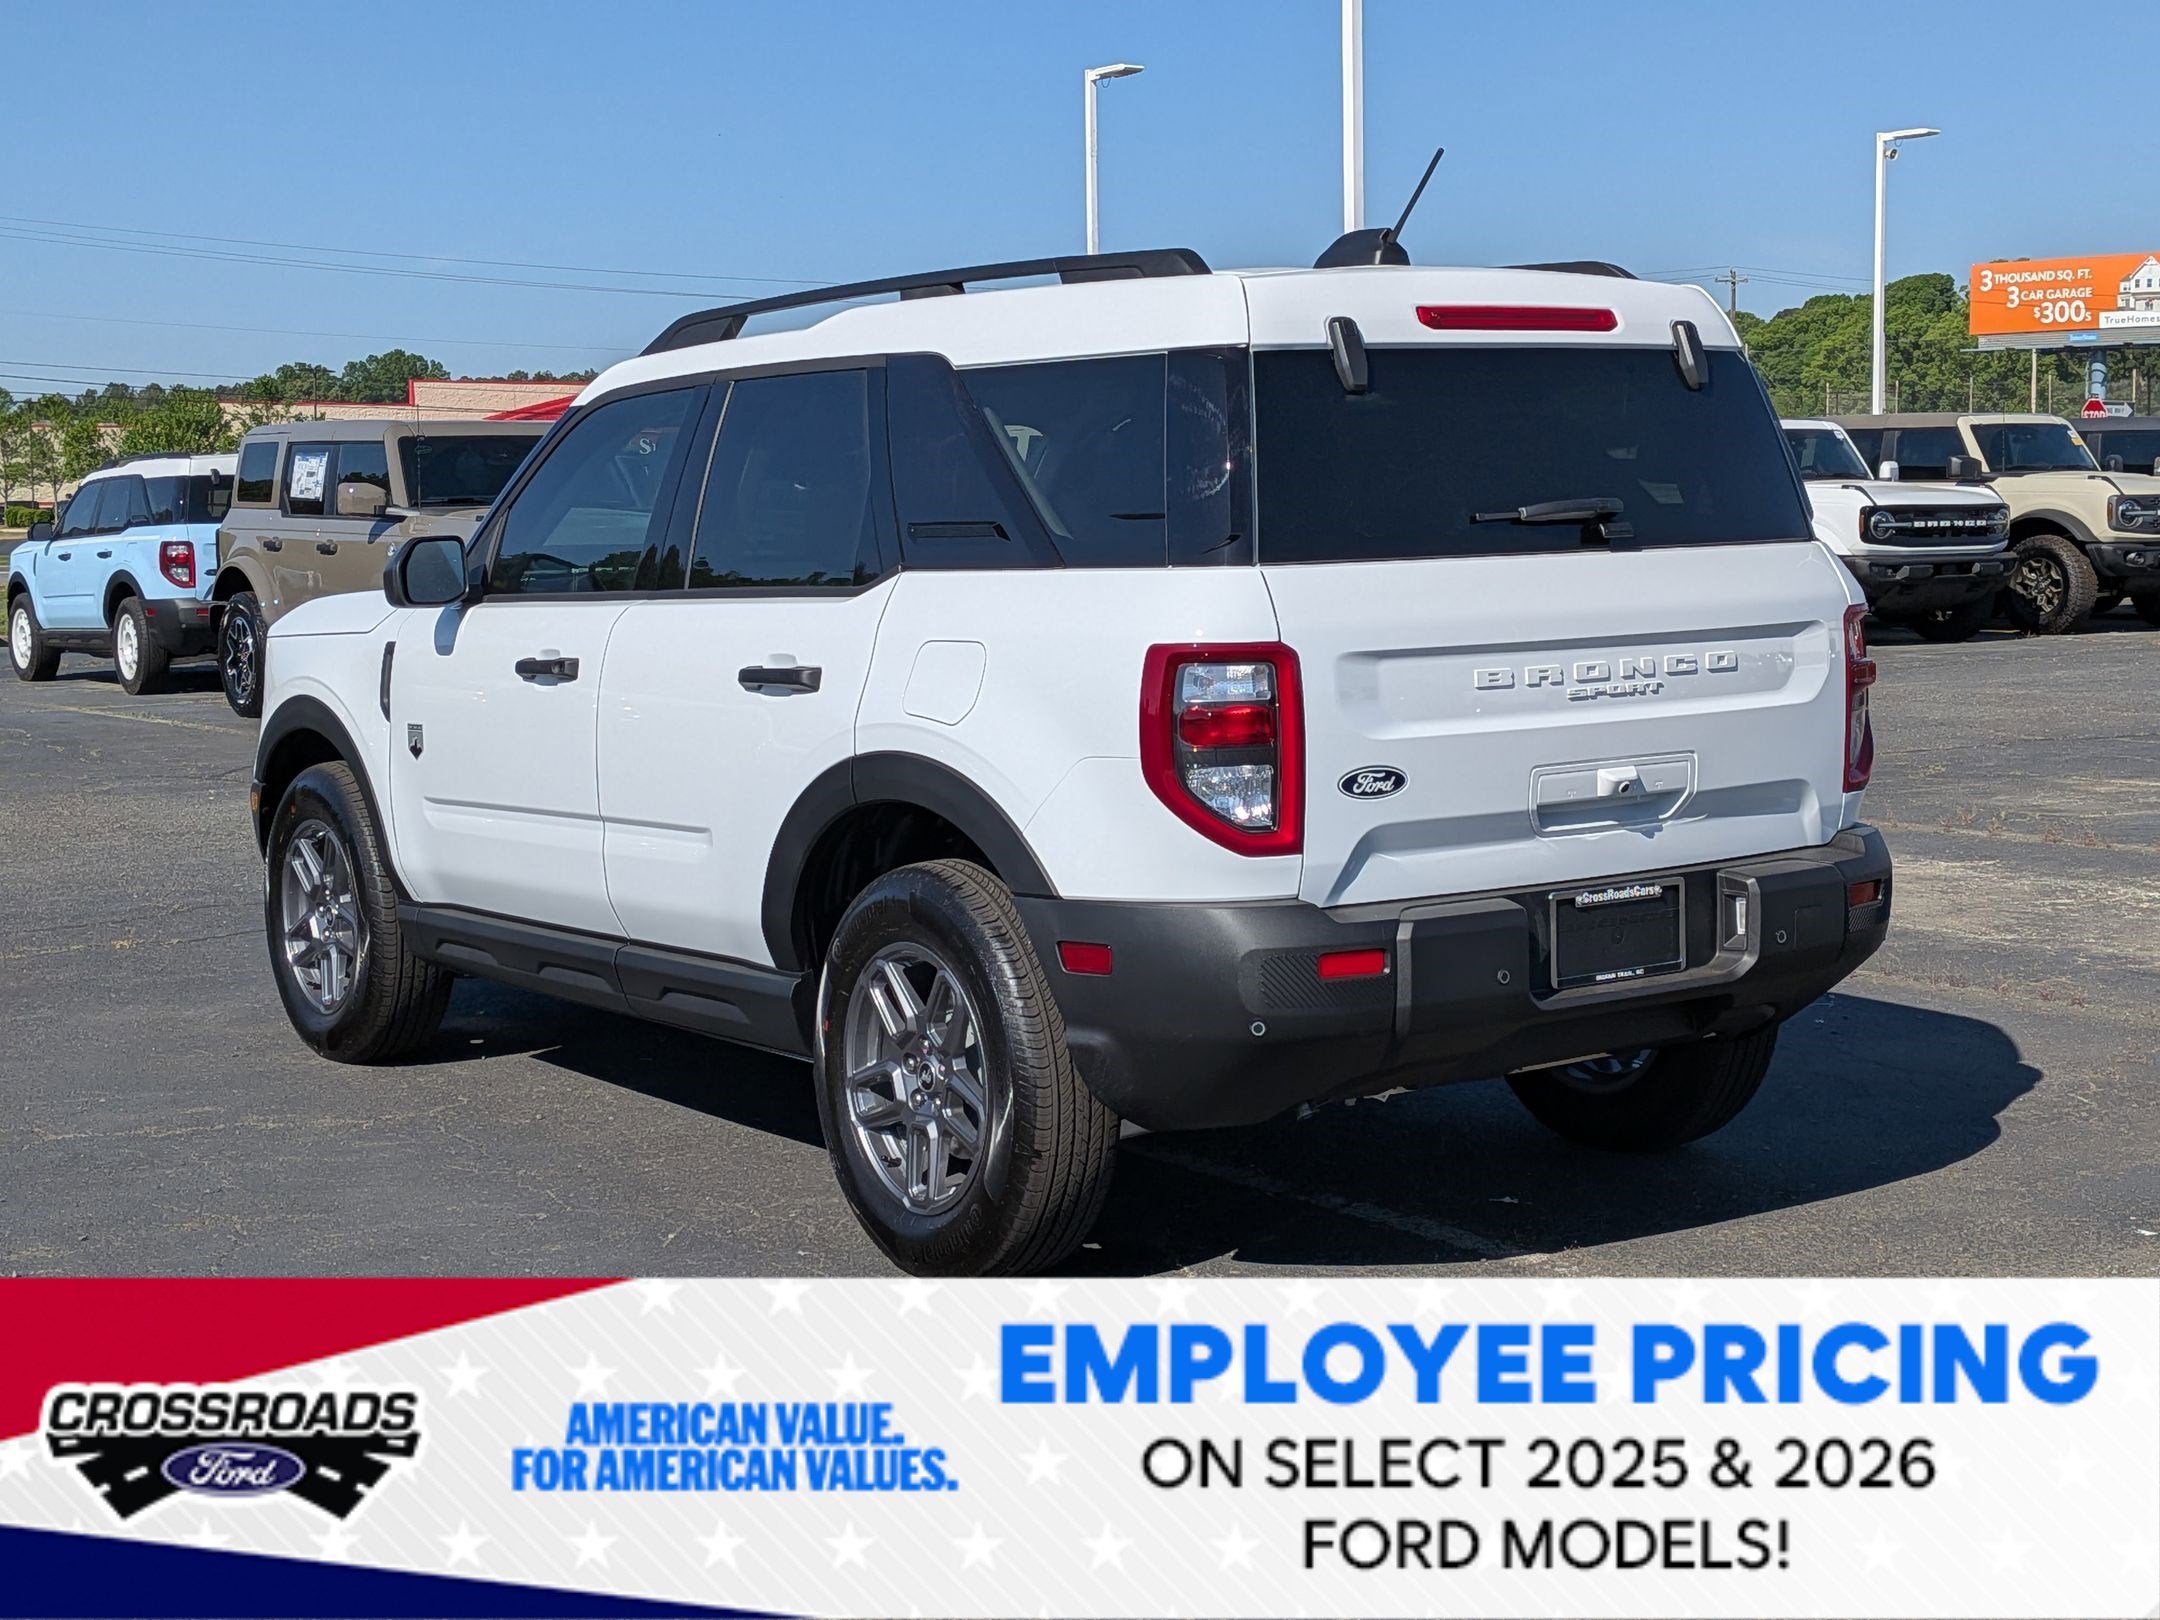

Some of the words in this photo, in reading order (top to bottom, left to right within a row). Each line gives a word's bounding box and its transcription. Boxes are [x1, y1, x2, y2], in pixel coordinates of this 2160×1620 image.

[1980, 269, 1993, 292] 3
[1994, 271, 2055, 285] THOUSAND
[2056, 269, 2075, 282] SQ.
[2077, 268, 2093, 279] FT.
[2006, 286, 2020, 308] 3
[2021, 290, 2044, 300] CAR
[2046, 287, 2093, 299] GARAGE
[1473, 650, 1739, 691] BRONCO
[1566, 680, 1664, 701] SPORT
[1352, 772, 1396, 793] Ford
